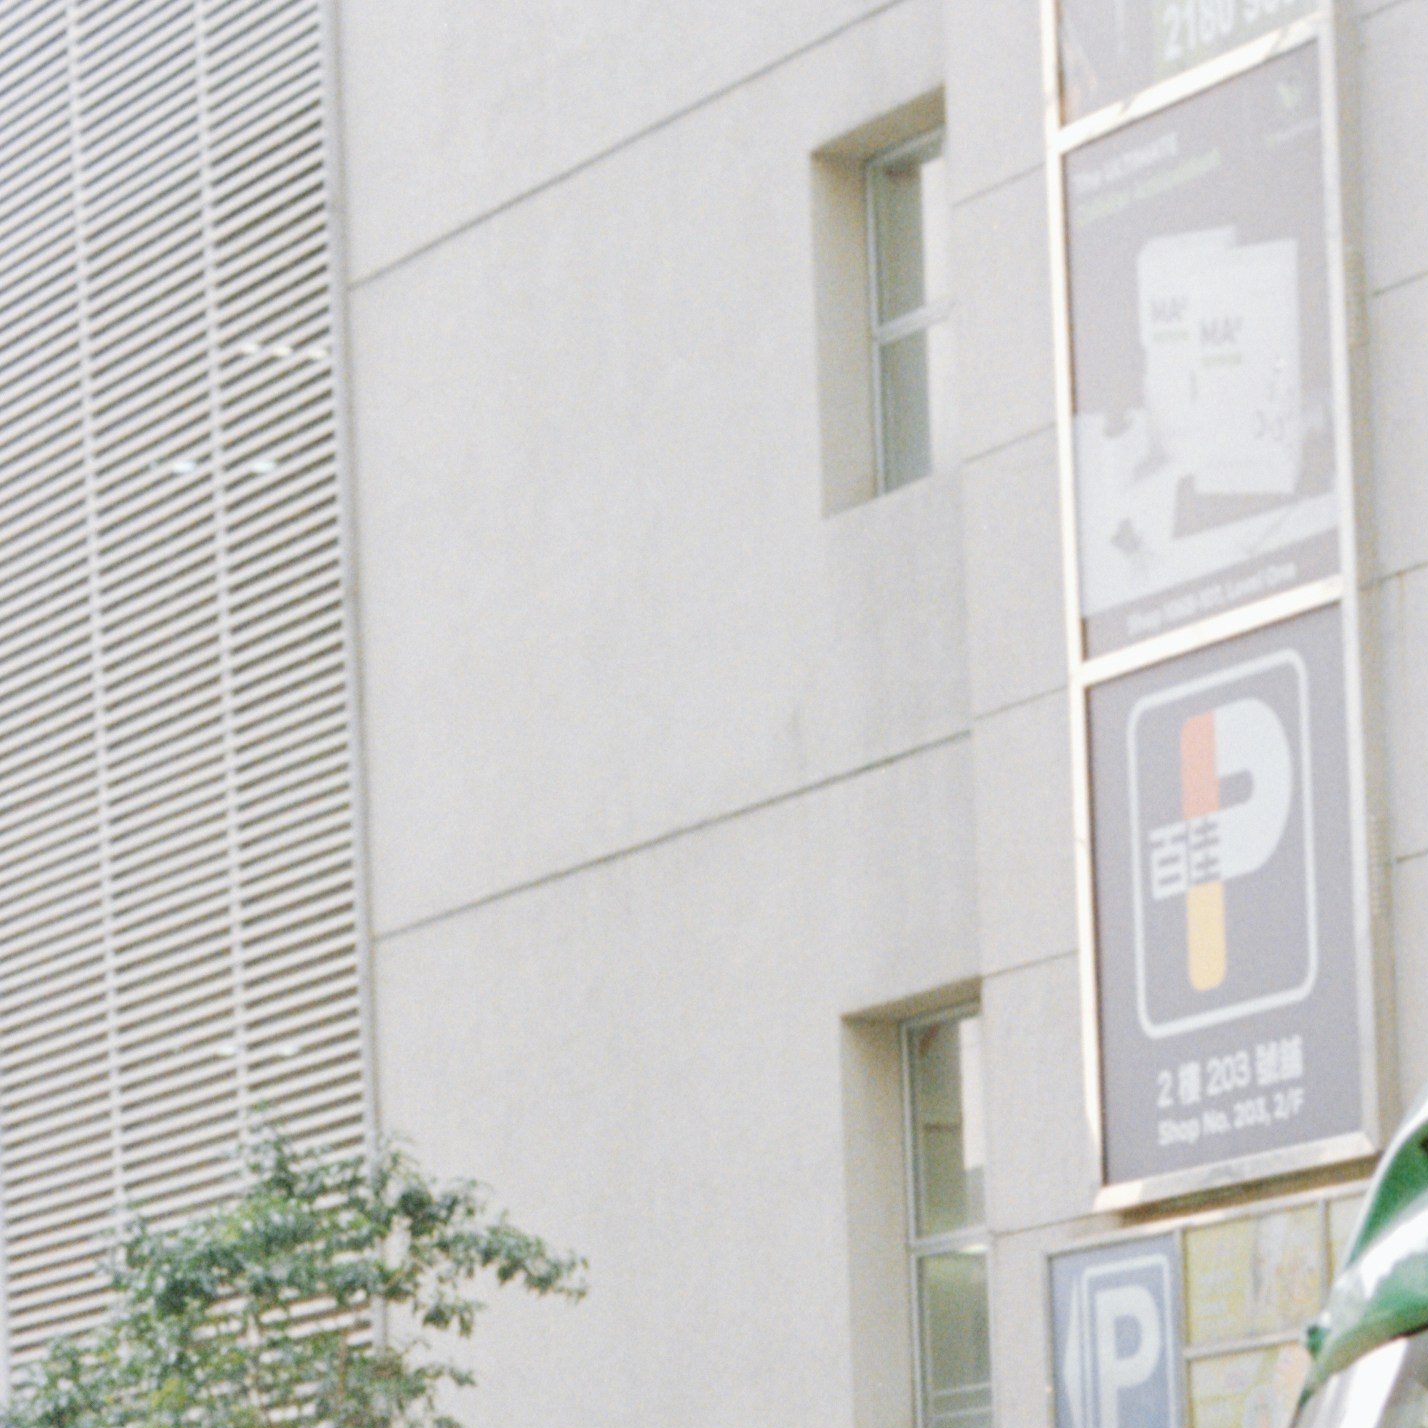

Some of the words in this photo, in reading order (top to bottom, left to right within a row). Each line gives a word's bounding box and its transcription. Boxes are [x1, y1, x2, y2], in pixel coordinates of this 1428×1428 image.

[1157, 1117, 1201, 1147] Shop
[1202, 1109, 1231, 1136] No.
[1273, 1086, 1305, 1120] 2/F
